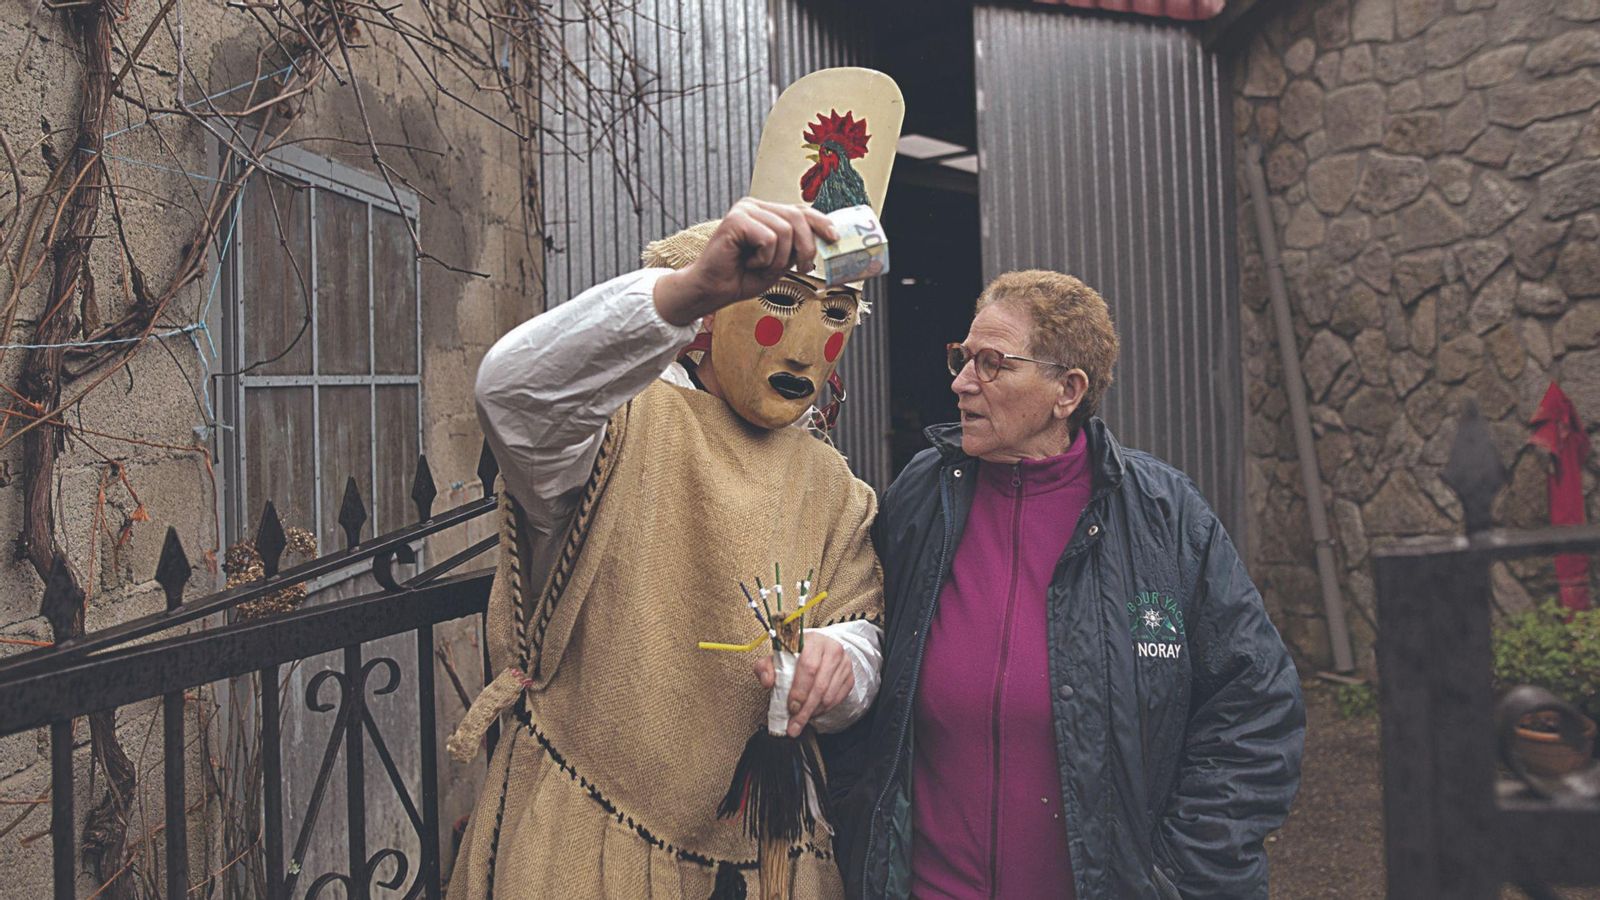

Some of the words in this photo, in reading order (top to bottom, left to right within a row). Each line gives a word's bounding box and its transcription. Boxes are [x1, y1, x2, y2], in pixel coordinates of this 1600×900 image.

[855, 219, 882, 247] 20
[1127, 591, 1160, 614] BOUR
[1138, 642, 1181, 659] NORAY
